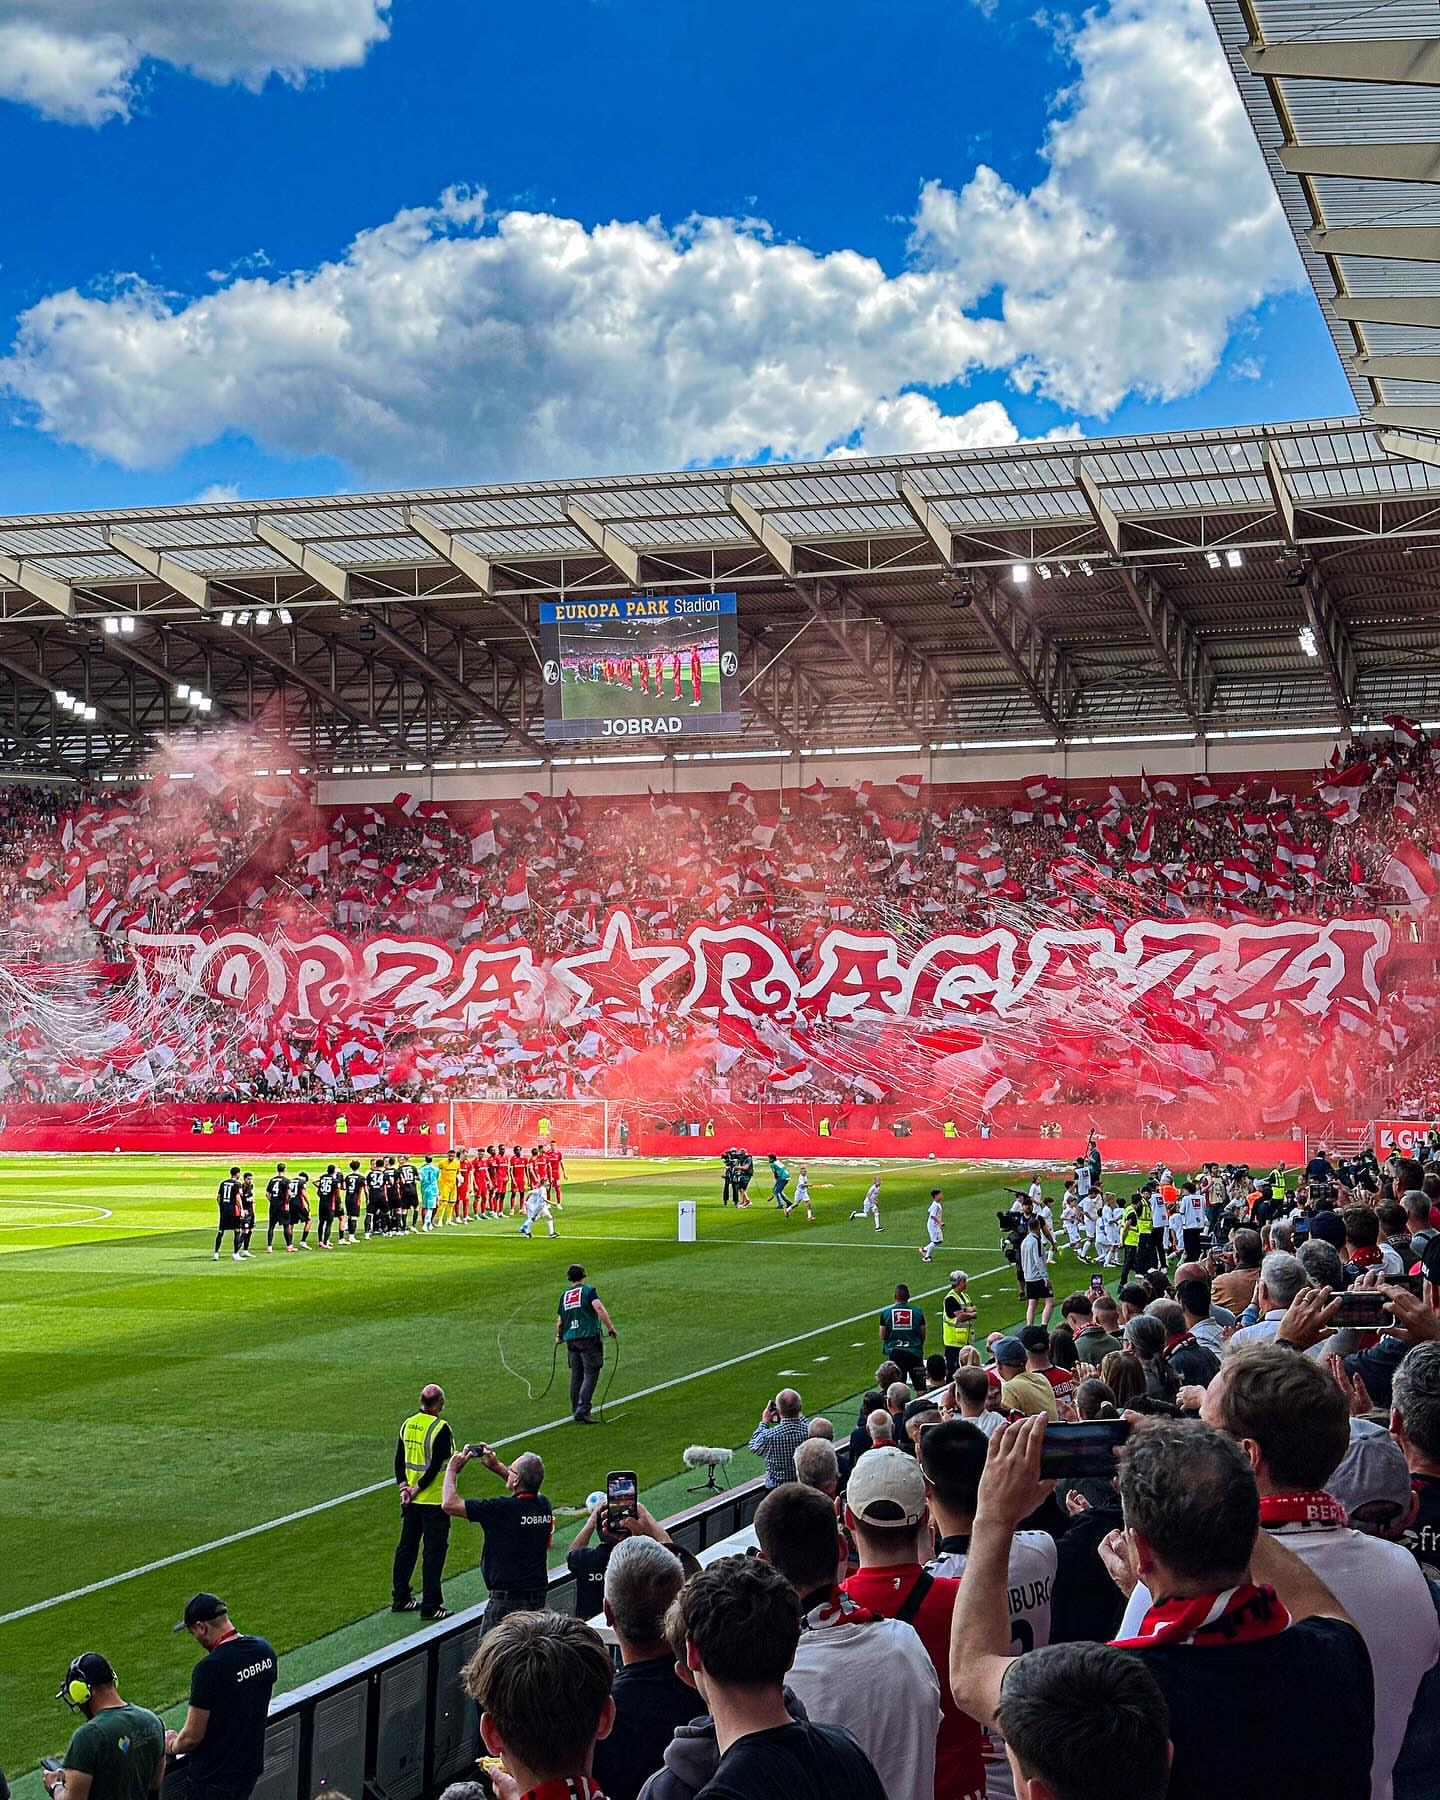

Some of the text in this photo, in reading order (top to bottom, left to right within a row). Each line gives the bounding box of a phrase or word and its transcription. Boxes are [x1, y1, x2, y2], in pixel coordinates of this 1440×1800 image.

[555, 597, 720, 620] EUROPA PARK Stadion
[601, 717, 682, 736] JOBRAD
[370, 1173, 384, 1186] 34
[402, 1168, 414, 1181] 16
[272, 1181, 280, 1194] 4
[320, 1179, 332, 1193] 36
[349, 1178, 356, 1190] 3
[223, 1184, 232, 1199] 11
[520, 1514, 552, 1525] JOBRAD
[235, 1657, 273, 1683] JOBRAD
